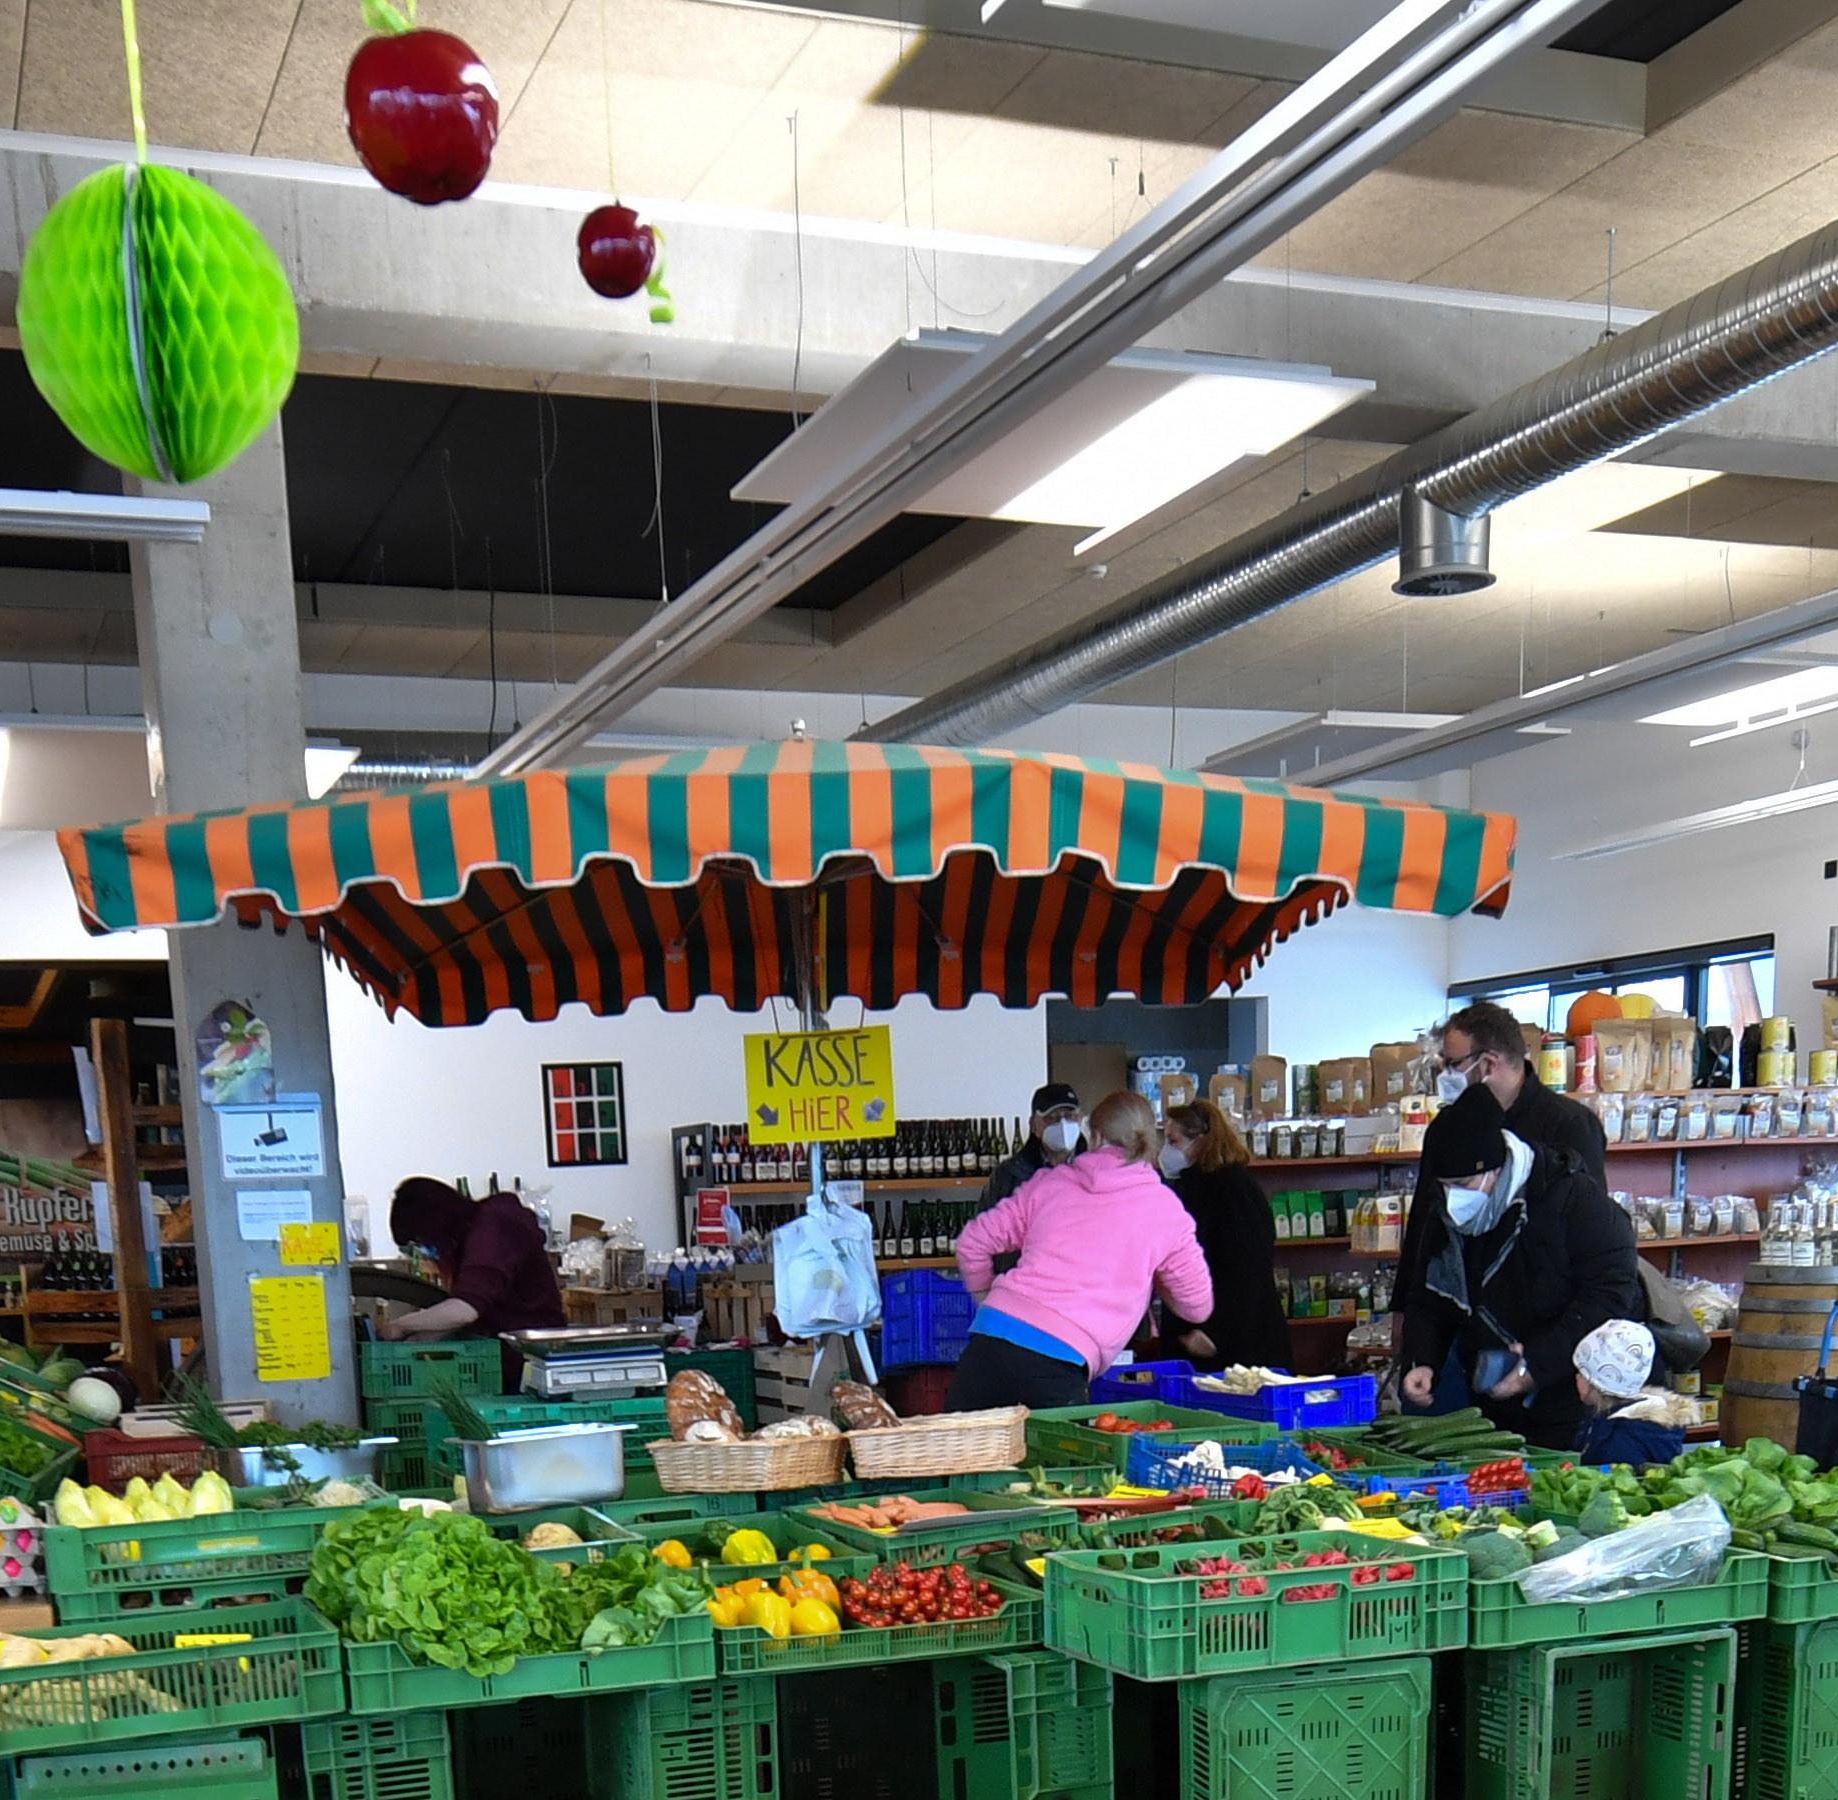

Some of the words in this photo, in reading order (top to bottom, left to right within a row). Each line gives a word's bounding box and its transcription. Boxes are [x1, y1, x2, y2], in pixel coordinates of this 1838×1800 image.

[764, 1034, 875, 1087] KASSE
[226, 1154, 256, 1163] Dieser
[260, 1154, 296, 1163] Bereich
[299, 1153, 319, 1161] wird
[58, 1230, 70, 1251] &
